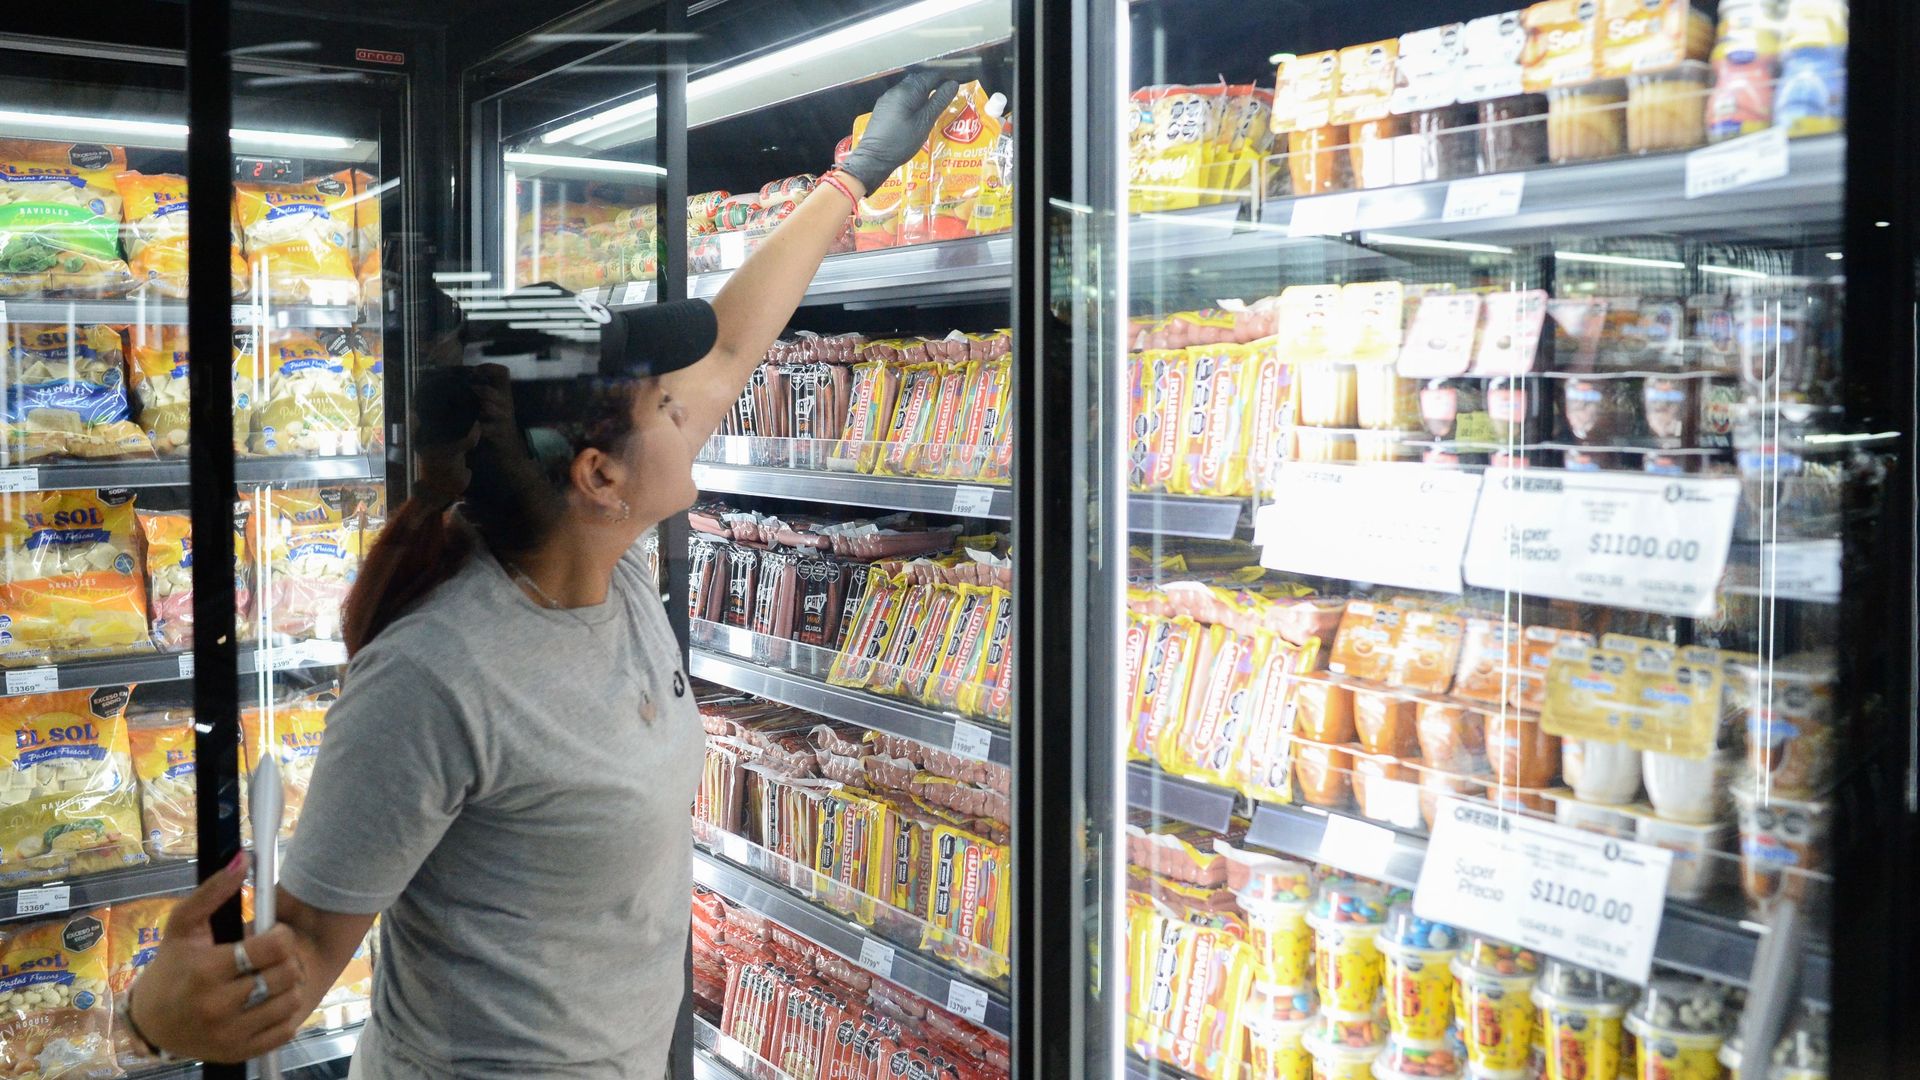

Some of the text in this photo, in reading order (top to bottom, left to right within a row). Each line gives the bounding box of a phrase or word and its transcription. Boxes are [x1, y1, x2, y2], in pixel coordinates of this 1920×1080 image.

[20, 207, 69, 216] RAVIOLES
[54, 507, 105, 527] SOL
[1589, 532, 1700, 562] $1100.00
[806, 596, 826, 608] PATY
[15, 723, 99, 749] EL SOL
[1454, 858, 1497, 880] Super
[1458, 878, 1504, 902] Precio
[1530, 878, 1633, 924] $1100.00
[20, 954, 69, 971] SOL
